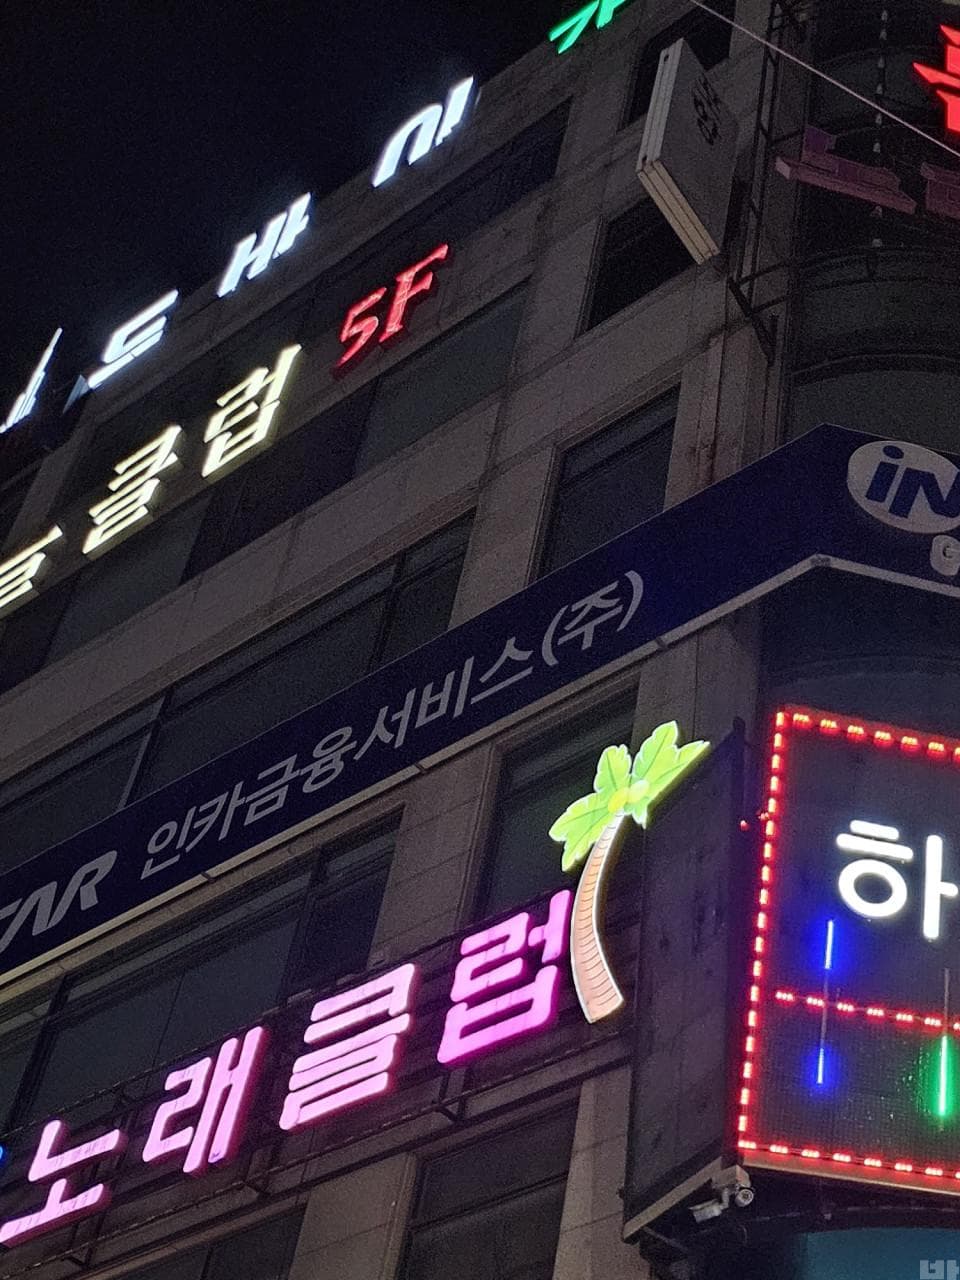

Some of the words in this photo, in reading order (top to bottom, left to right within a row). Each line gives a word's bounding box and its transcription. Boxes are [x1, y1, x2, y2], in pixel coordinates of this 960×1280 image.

[331, 242, 449, 378] 5F
[140, 569, 644, 880] 인카금융서비스(주)
[0, 888, 573, 1246] 노래클럽
